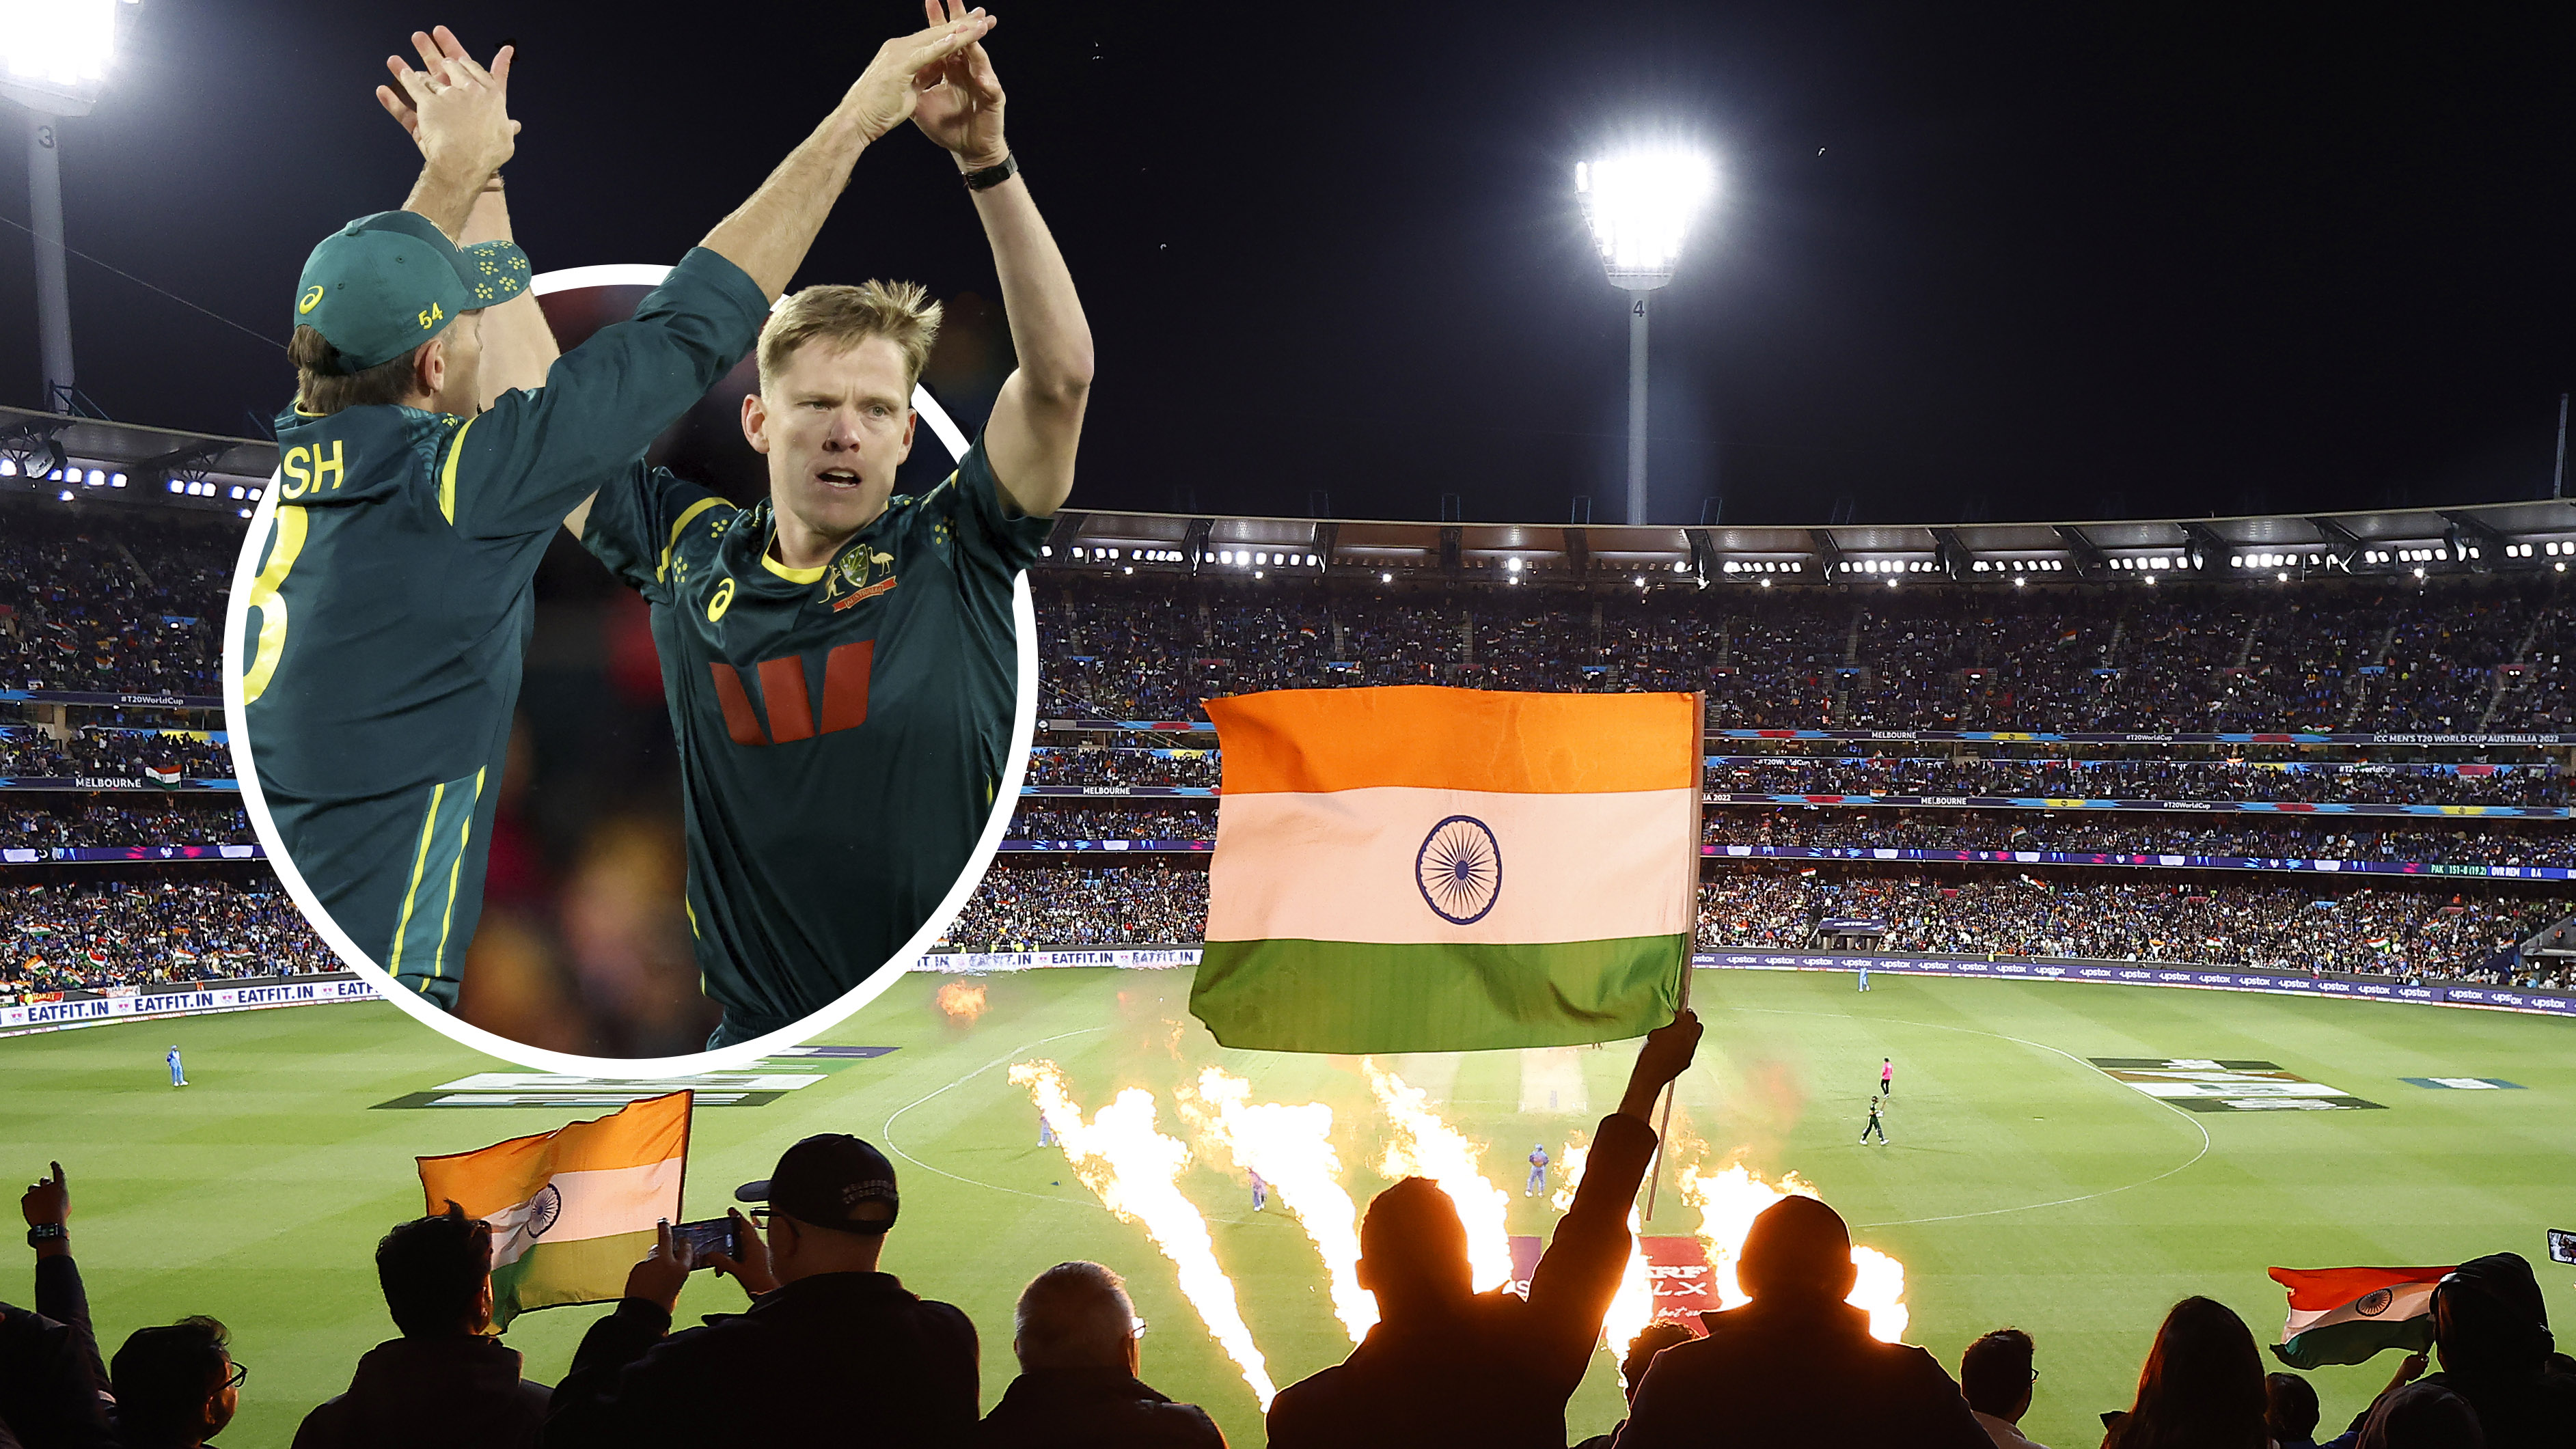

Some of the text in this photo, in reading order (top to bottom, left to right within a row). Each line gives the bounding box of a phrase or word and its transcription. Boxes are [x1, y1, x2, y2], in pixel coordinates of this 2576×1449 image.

[38, 126, 55, 148] 3
[1633, 300, 1645, 318] 4
[418, 302, 443, 330] 54
[277, 440, 344, 502] SH
[121, 695, 184, 706] #T20WorldCup
[1872, 731, 1917, 739] MELBOURNE
[2435, 734, 2467, 743] WORLD
[2469, 734, 2487, 743] CUP
[2488, 734, 2537, 743] AUSTRALIA
[75, 777, 142, 788] MELBOURNE
[1083, 787, 1131, 795] MELBOURNE
[2431, 864, 2444, 874] PAK
[2469, 866, 2487, 876] (19.2)
[2491, 868, 2505, 877] OVR
[2506, 868, 2520, 877] REM
[1052, 952, 1113, 964] EATFIT.IN
[1996, 965, 2027, 973] upstox
[2159, 973, 2191, 981] upstox
[2199, 975, 2230, 983] upstox
[2238, 977, 2270, 986] upstox
[2278, 980, 2310, 989] upstox
[2318, 983, 2350, 991] upstox
[2357, 986, 2390, 995] upstox
[2398, 989, 2430, 997] upstox
[2449, 991, 2483, 999] upstox
[2531, 999, 2566, 1008] upstox
[28, 1002, 109, 1022] EATFIT.IN
[134, 993, 213, 1011] EATFIT.IN
[238, 985, 314, 1004] EATFIT.IN
